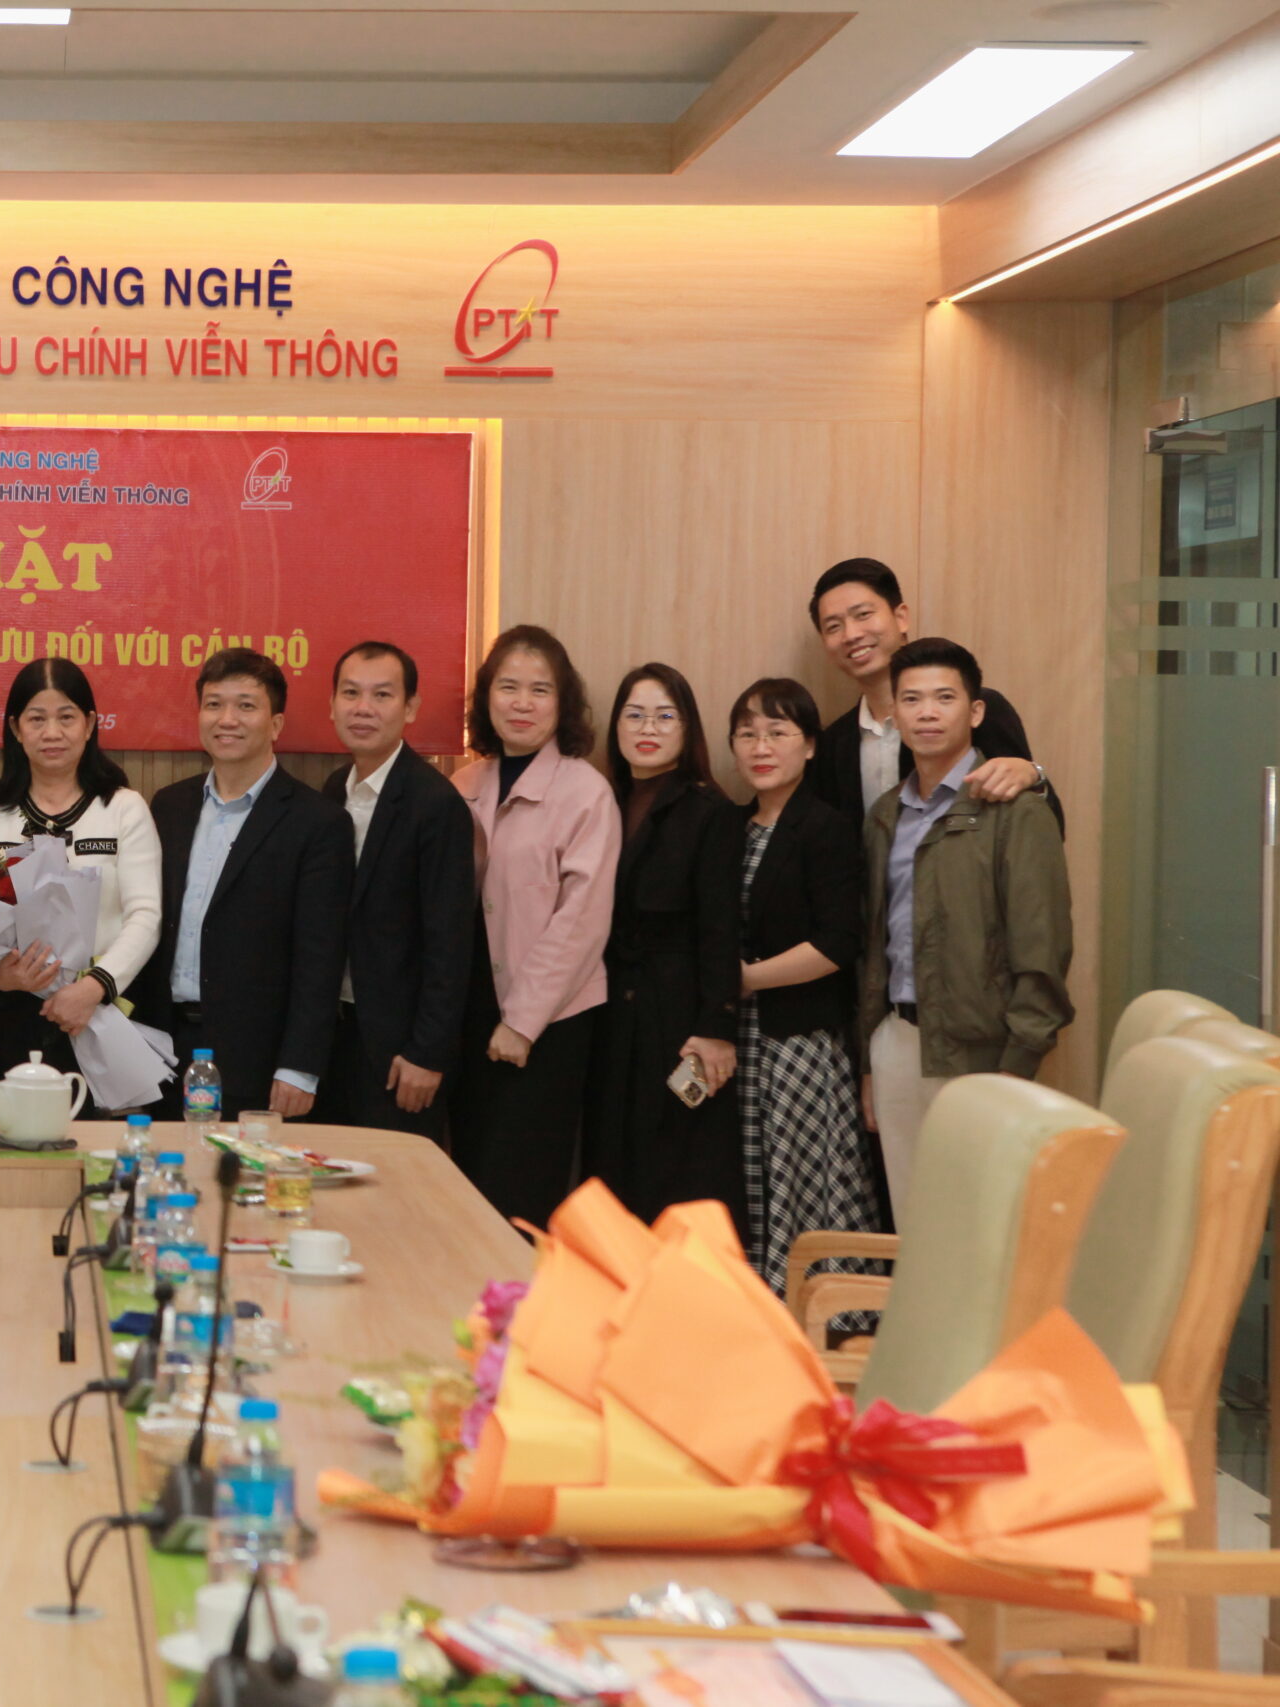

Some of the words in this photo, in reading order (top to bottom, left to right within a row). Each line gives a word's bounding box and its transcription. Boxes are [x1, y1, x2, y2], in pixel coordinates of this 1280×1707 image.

[12, 256, 145, 306] CÔNG
[164, 259, 292, 316] NGHỆ
[35, 326, 147, 376] CHÍNH
[165, 321, 247, 376] VIỄN
[264, 329, 398, 378] THÔNG
[37, 449, 100, 474] NGHỆ
[57, 478, 107, 503] VIỄN
[114, 484, 190, 505] THÔNG
[45, 621, 103, 665] ĐỐI
[115, 626, 169, 666] VỚI
[264, 628, 309, 676] BỘ
[78, 841, 116, 851] CHANEL
